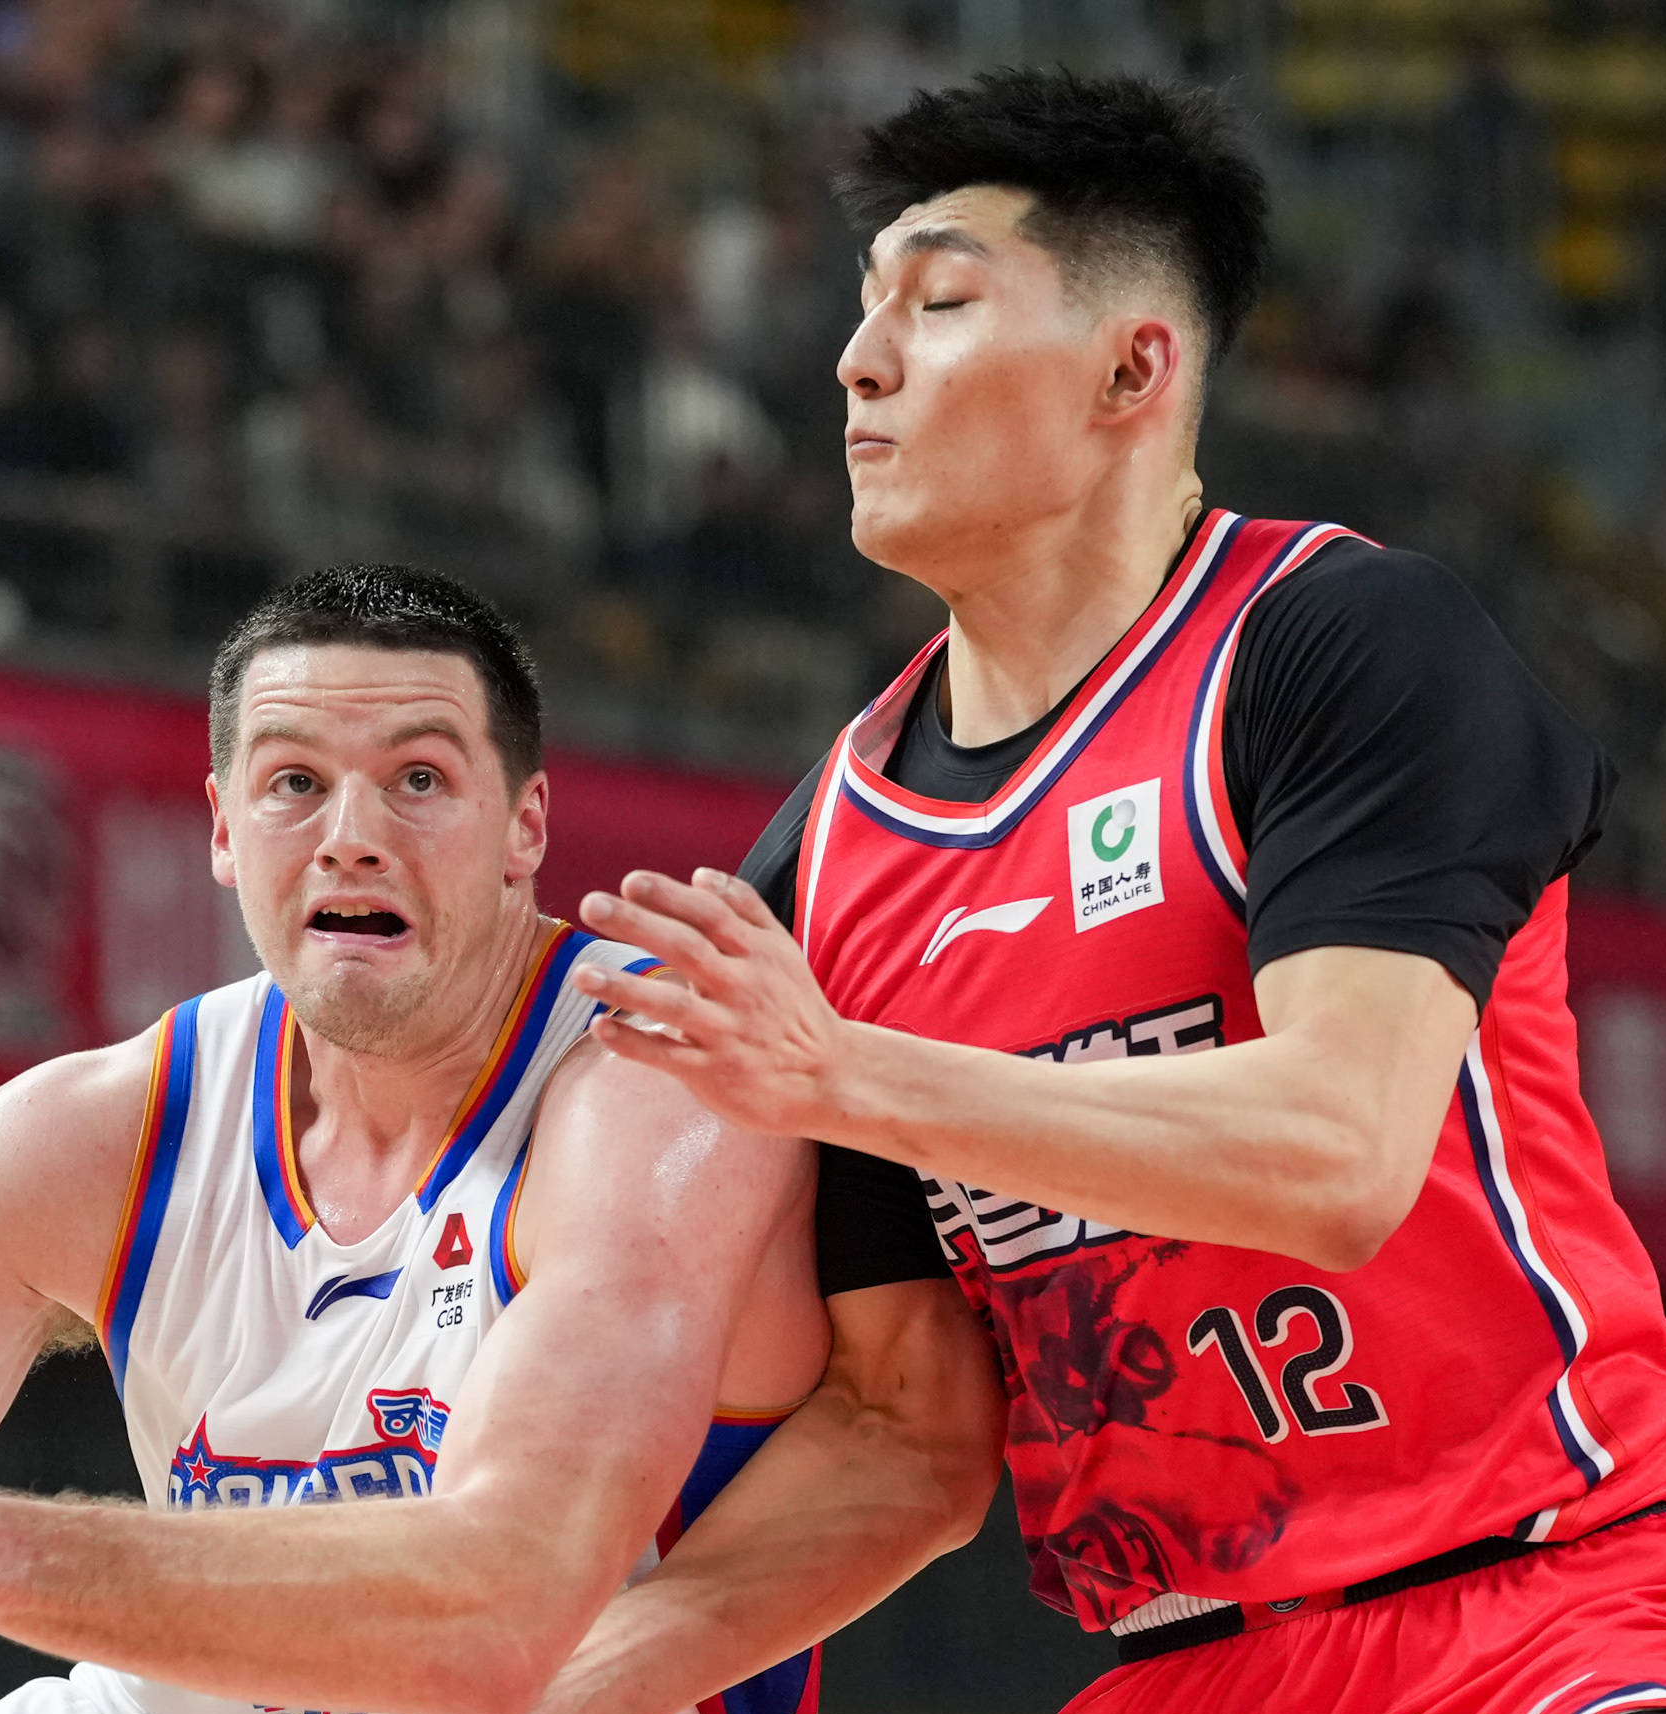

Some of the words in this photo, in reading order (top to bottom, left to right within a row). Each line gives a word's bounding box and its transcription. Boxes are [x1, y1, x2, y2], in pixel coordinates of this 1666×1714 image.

[1081, 861, 1151, 901] 中国人寿
[1083, 895, 1120, 917] CHINA
[1124, 882, 1152, 900] LIFE
[431, 1278, 474, 1307] 广发银行
[437, 1305, 463, 1329] CGB
[1186, 1284, 1390, 1445] 12
